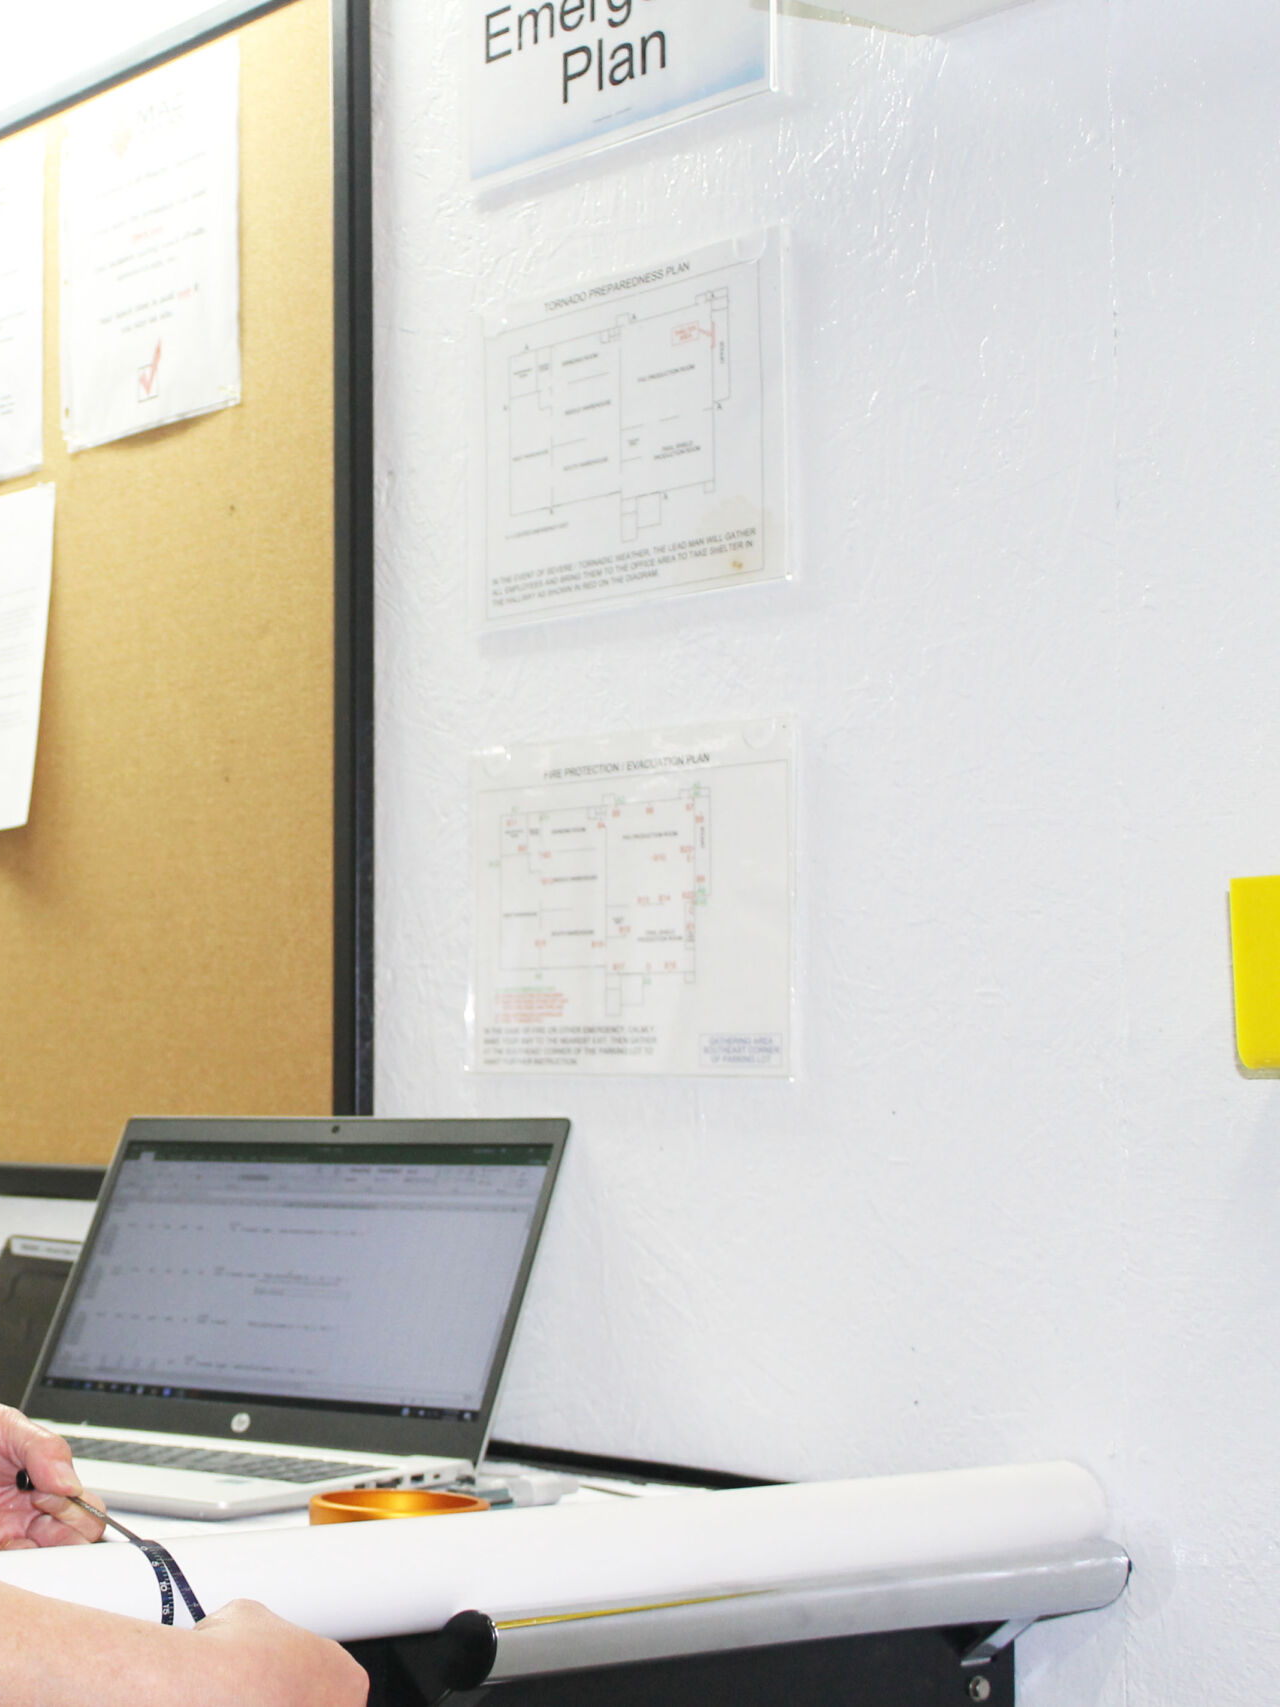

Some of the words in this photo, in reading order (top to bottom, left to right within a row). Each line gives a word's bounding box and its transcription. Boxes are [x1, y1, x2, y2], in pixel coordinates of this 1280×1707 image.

[562, 30, 666, 104] Plan
[544, 290, 586, 312] TORNADO
[588, 269, 664, 298] PREPAREDNESS
[666, 261, 690, 277] PLAN
[668, 541, 687, 552] LEAD
[688, 538, 704, 548] MAN
[706, 534, 722, 544] WILL
[724, 528, 756, 541] GATHER
[604, 566, 614, 575] TO
[616, 564, 628, 572] THE
[630, 558, 656, 570] OFFICE
[657, 554, 676, 565] AREA
[677, 552, 688, 560] TO
[689, 548, 708, 558] TAKE
[709, 540, 744, 555] SHELTER
[746, 540, 754, 548] IN
[610, 575, 624, 584] THE
[544, 767, 562, 780] FIRE
[564, 762, 620, 777] PROTECTION
[626, 755, 684, 772] EVACUATION
[685, 752, 710, 764] PLAN
[160, 1581, 168, 1592] 10
